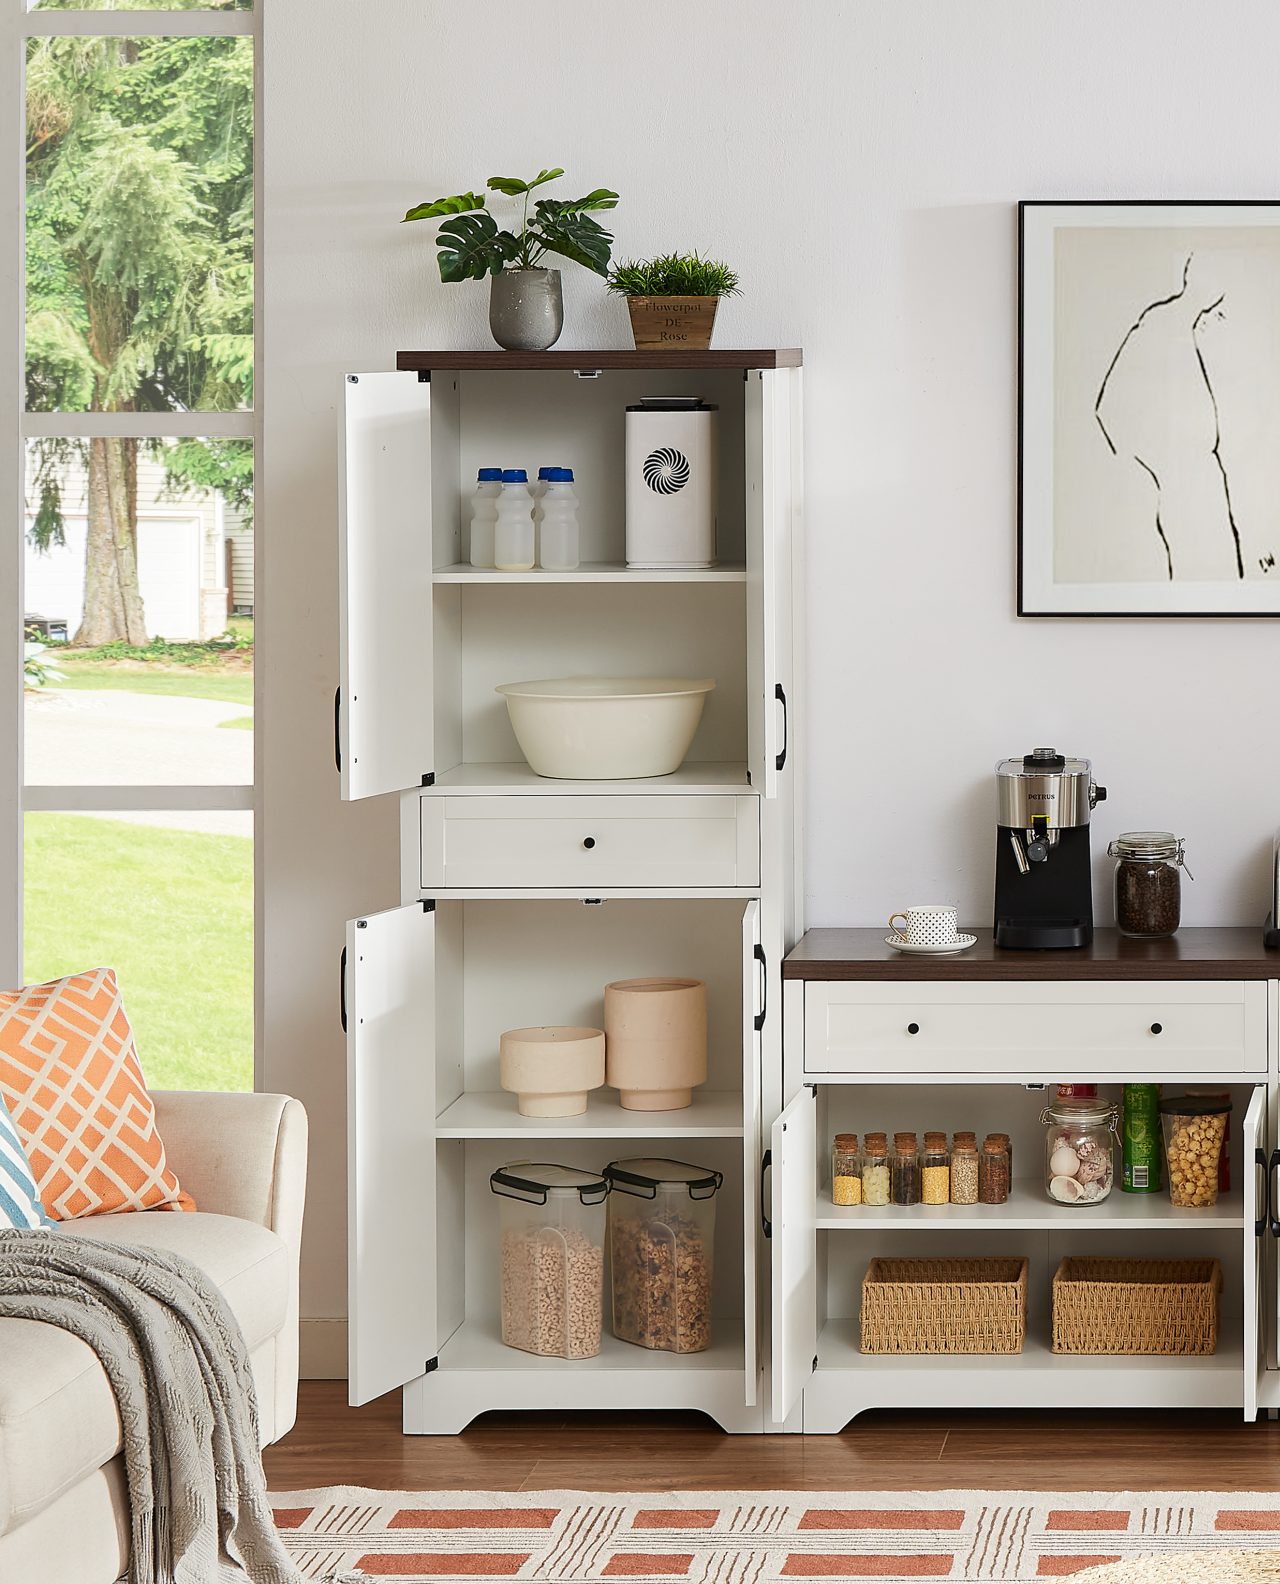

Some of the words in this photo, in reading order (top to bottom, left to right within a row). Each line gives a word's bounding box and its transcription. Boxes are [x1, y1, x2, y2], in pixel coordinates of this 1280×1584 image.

[645, 302, 701, 314] Flowerpot
[665, 318, 682, 327] DE
[660, 331, 688, 341] Rose
